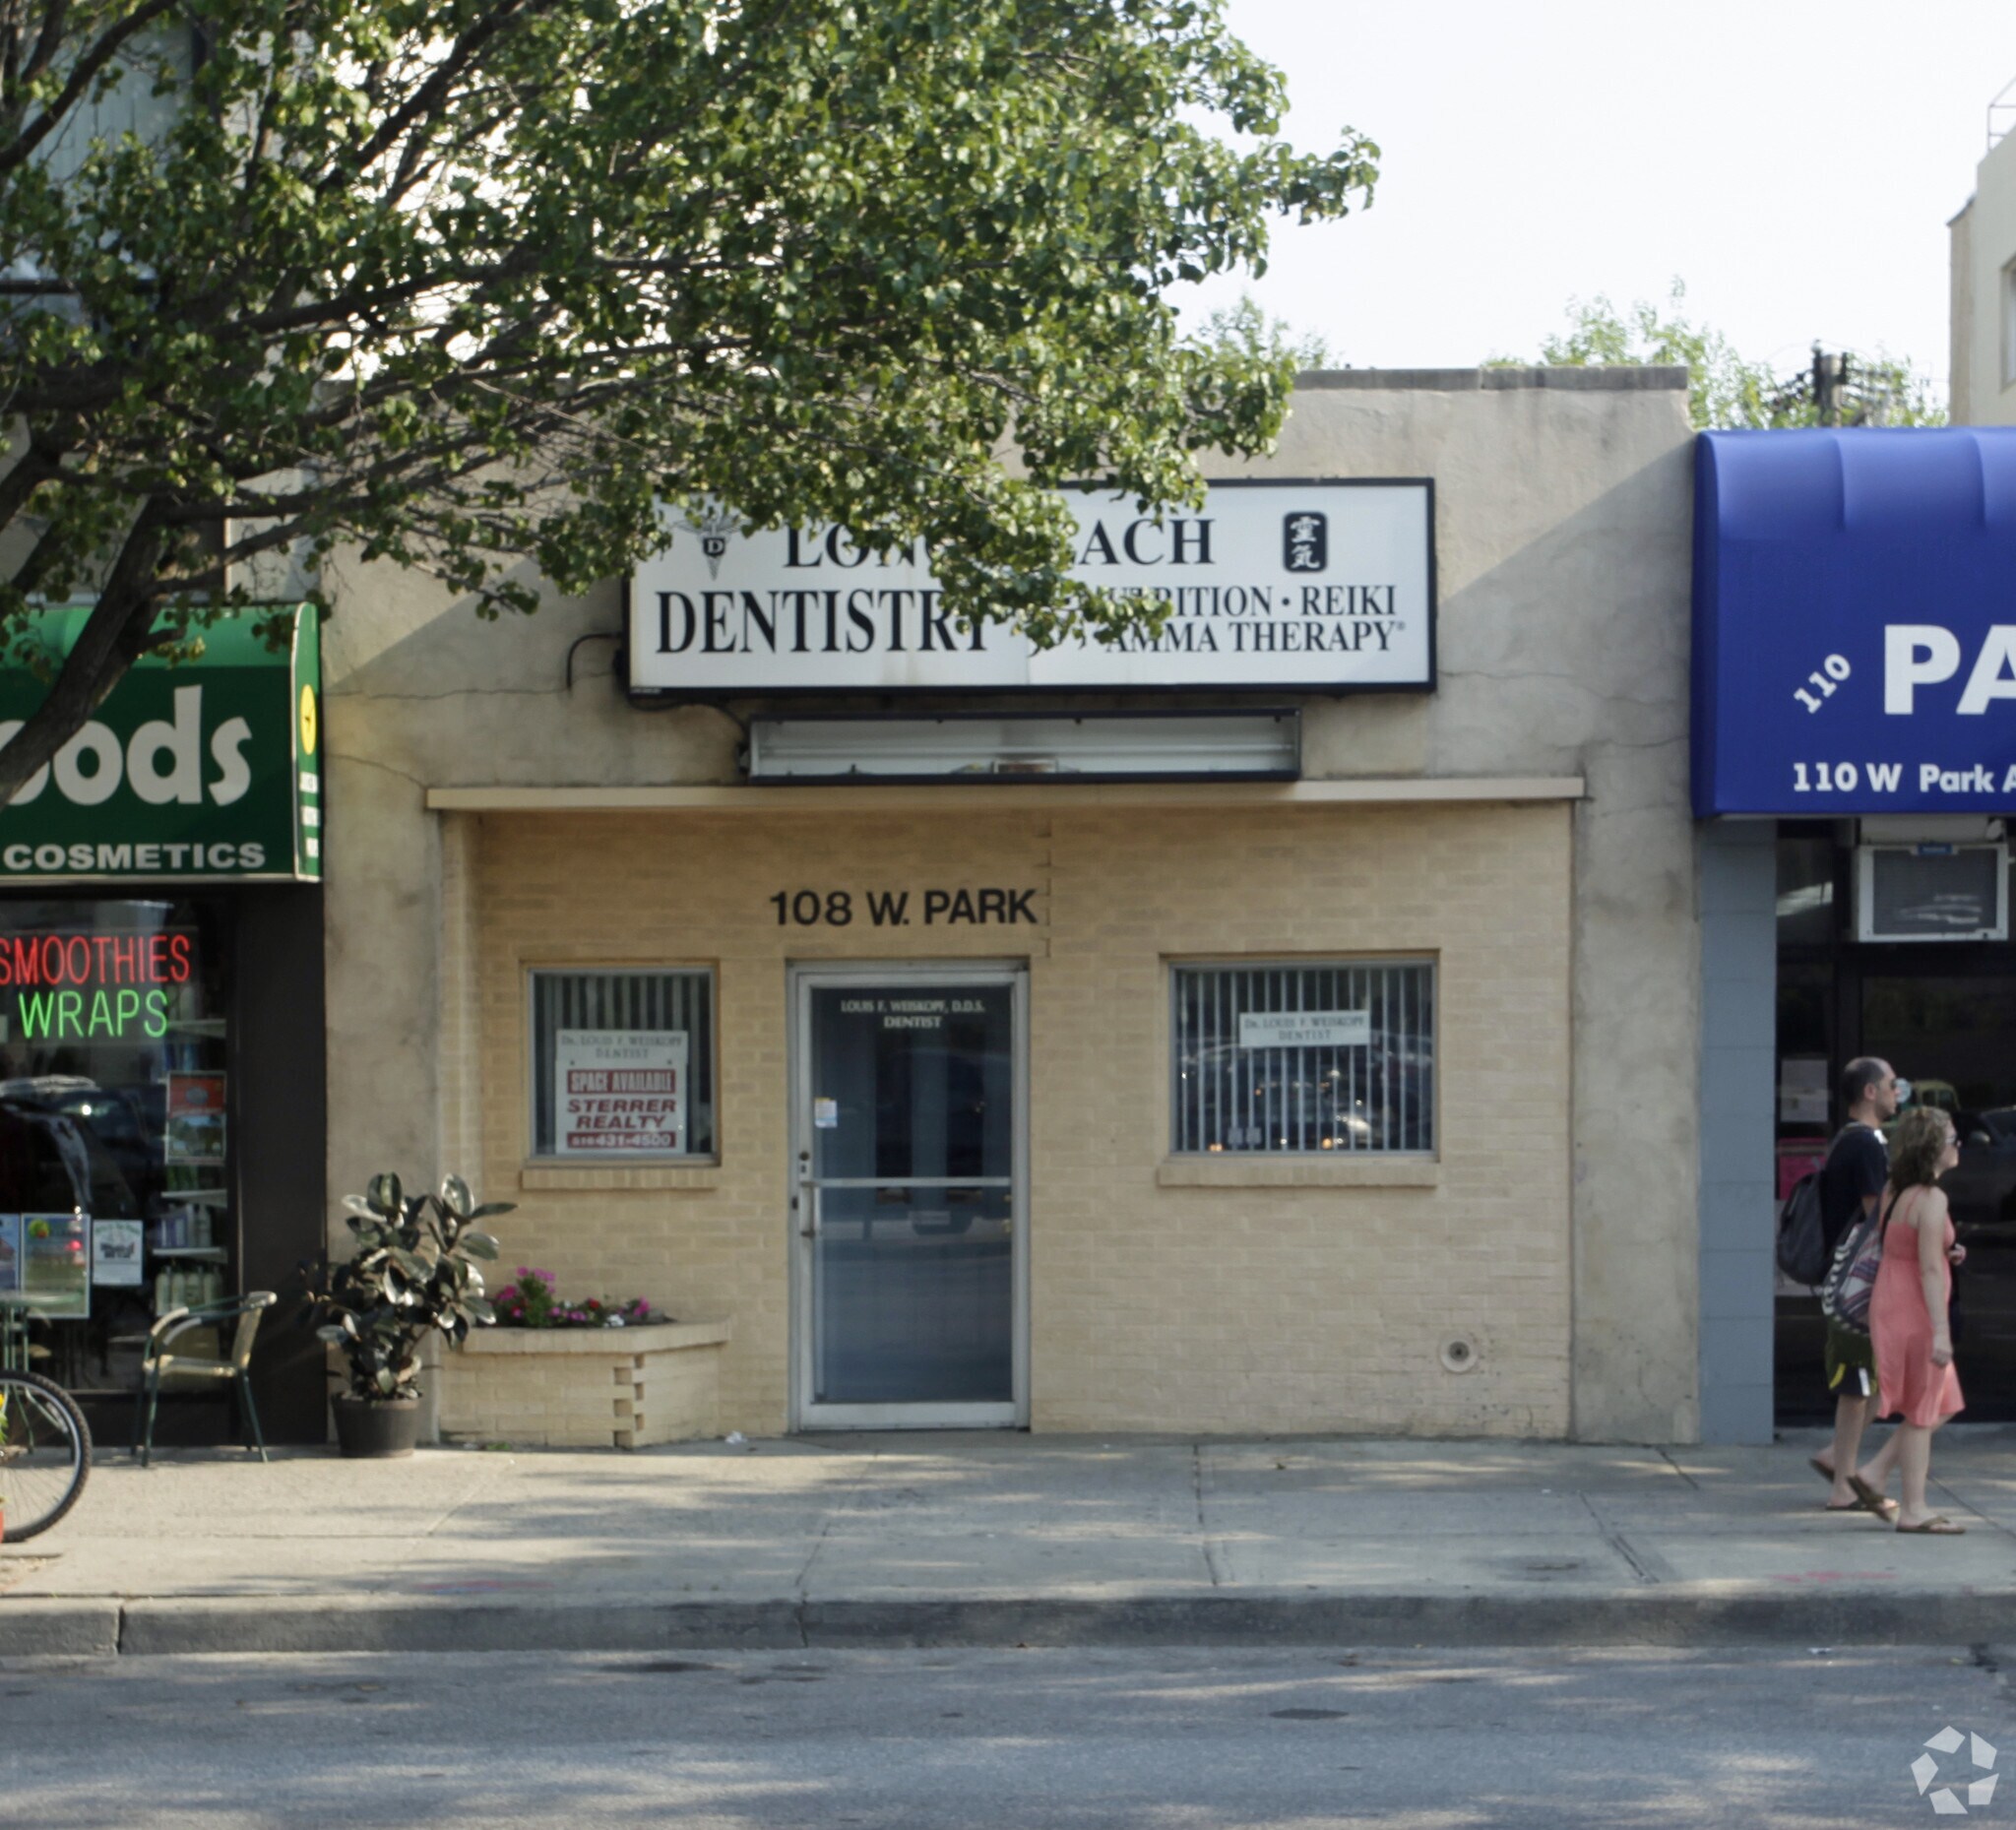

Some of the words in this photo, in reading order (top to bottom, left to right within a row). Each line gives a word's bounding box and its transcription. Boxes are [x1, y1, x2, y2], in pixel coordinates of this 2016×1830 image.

[783, 519, 937, 568] LO
[1071, 518, 1216, 566] ACH
[1300, 586, 1396, 616] REIKI
[1793, 654, 1852, 714] 110
[1793, 762, 1858, 791] 110
[1865, 763, 1903, 792] W
[1920, 763, 1994, 793] Park
[3, 843, 266, 870] COSMETICS
[770, 890, 853, 926] 108
[866, 891, 910, 926] W.
[924, 888, 1038, 925] PARK
[0, 934, 191, 985] SMOOTHIES
[19, 989, 169, 1040] WRAPS
[884, 1015, 942, 1029] DENTIST
[1279, 1029, 1332, 1041] DENTIST
[567, 1099, 677, 1113] STERRER
[576, 1115, 665, 1129] REALTY
